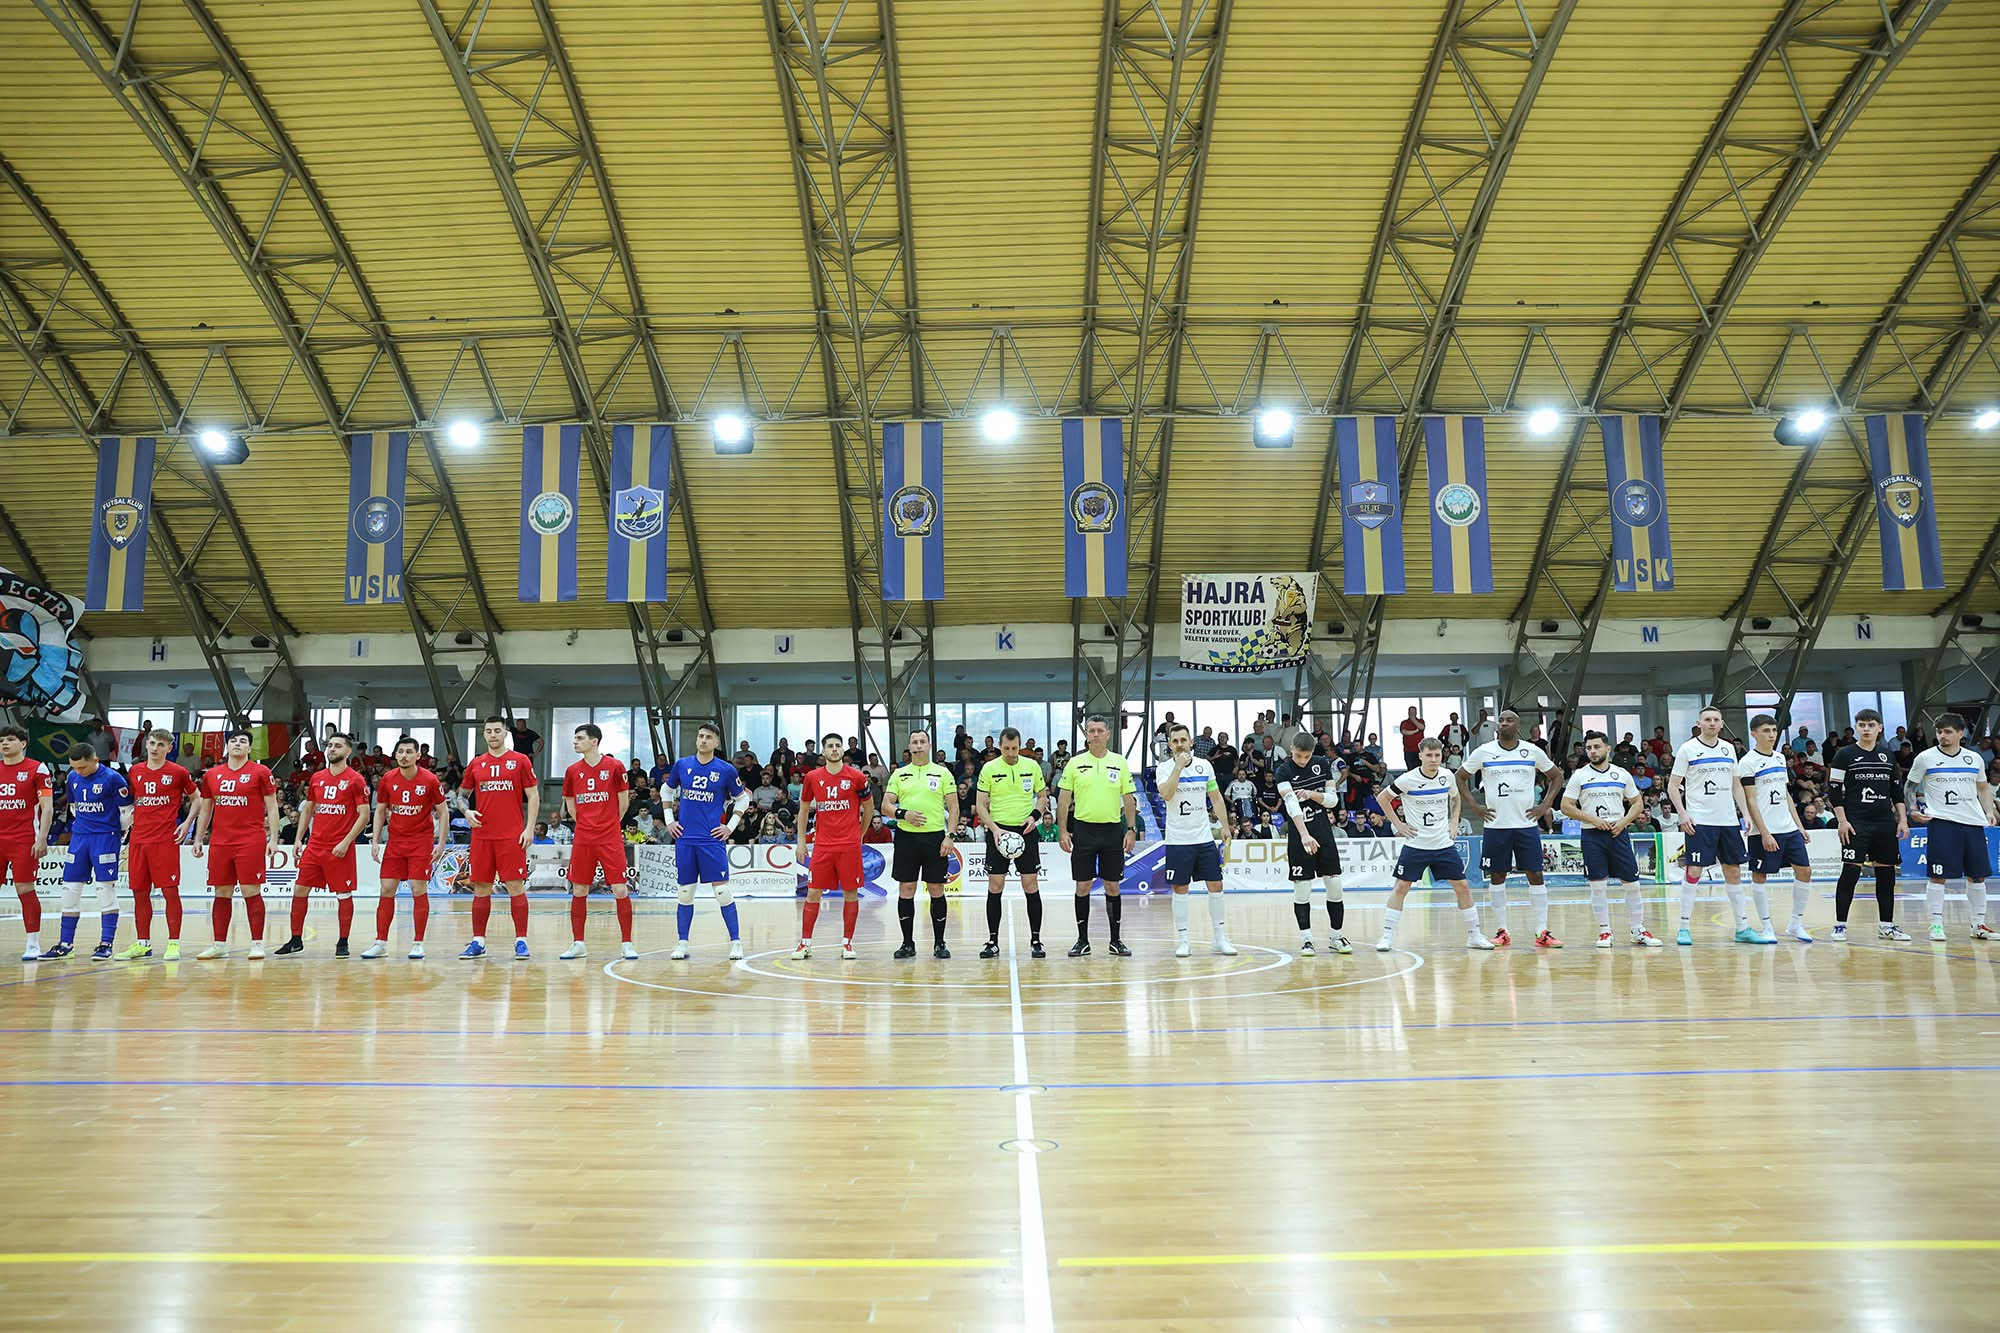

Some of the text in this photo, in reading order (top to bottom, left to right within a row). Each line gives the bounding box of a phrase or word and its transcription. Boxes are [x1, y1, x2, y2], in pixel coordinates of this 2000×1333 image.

[1880, 476, 1904, 488] FUTSAL
[102, 498, 126, 510] FUTSAL
[1187, 576, 1265, 604] HAJRÁ
[1185, 609, 1266, 626] SPORTKLUB!
[1642, 626, 1658, 642] M
[1857, 623, 1870, 639] N
[779, 637, 789, 653] J
[999, 632, 1013, 650] K
[1184, 635, 1210, 643] VELETEK
[152, 645, 164, 661] H
[1181, 658, 1306, 673] SZÉKELYUDVARHELY
[490, 765, 500, 777] 11
[144, 782, 156, 794] 18
[219, 779, 236, 792] 20
[587, 778, 595, 790] 9
[692, 775, 708, 789] 23
[0, 783, 16, 796] 36
[82, 789, 87, 801] 1
[324, 785, 337, 800] 19
[826, 786, 838, 799] 14
[402, 790, 410, 803] 8
[1338, 840, 1400, 862] ETAL
[1843, 848, 1856, 860] 23
[1481, 857, 1491, 867] 14
[1691, 852, 1701, 863] 11
[1756, 858, 1763, 869] 7
[1166, 869, 1175, 880] 17
[1266, 866, 1281, 874] IN
[1291, 866, 1303, 876] 22
[1397, 864, 1404, 875] 5
[1932, 864, 1943, 875] 18
